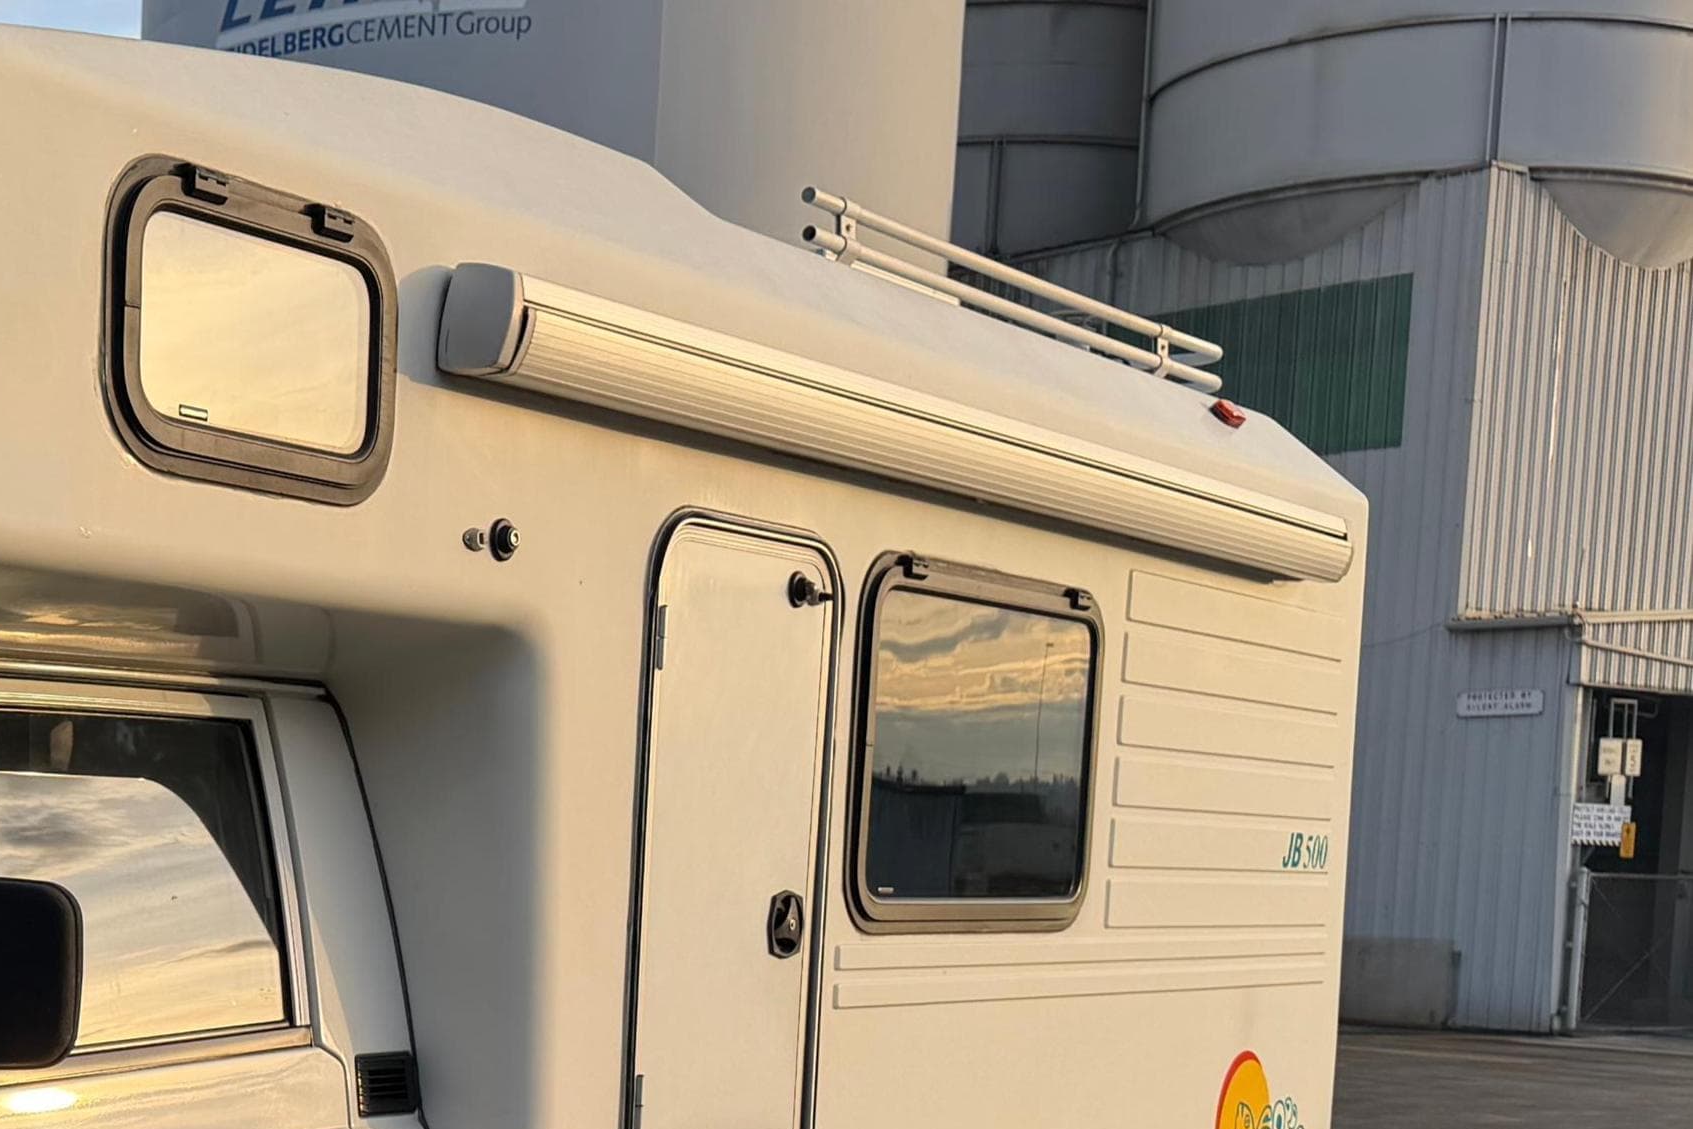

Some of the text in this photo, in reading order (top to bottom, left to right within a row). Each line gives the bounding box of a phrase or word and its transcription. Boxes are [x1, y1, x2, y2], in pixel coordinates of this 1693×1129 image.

[456, 11, 532, 40] Group
[1282, 832, 1328, 869] JB 500
